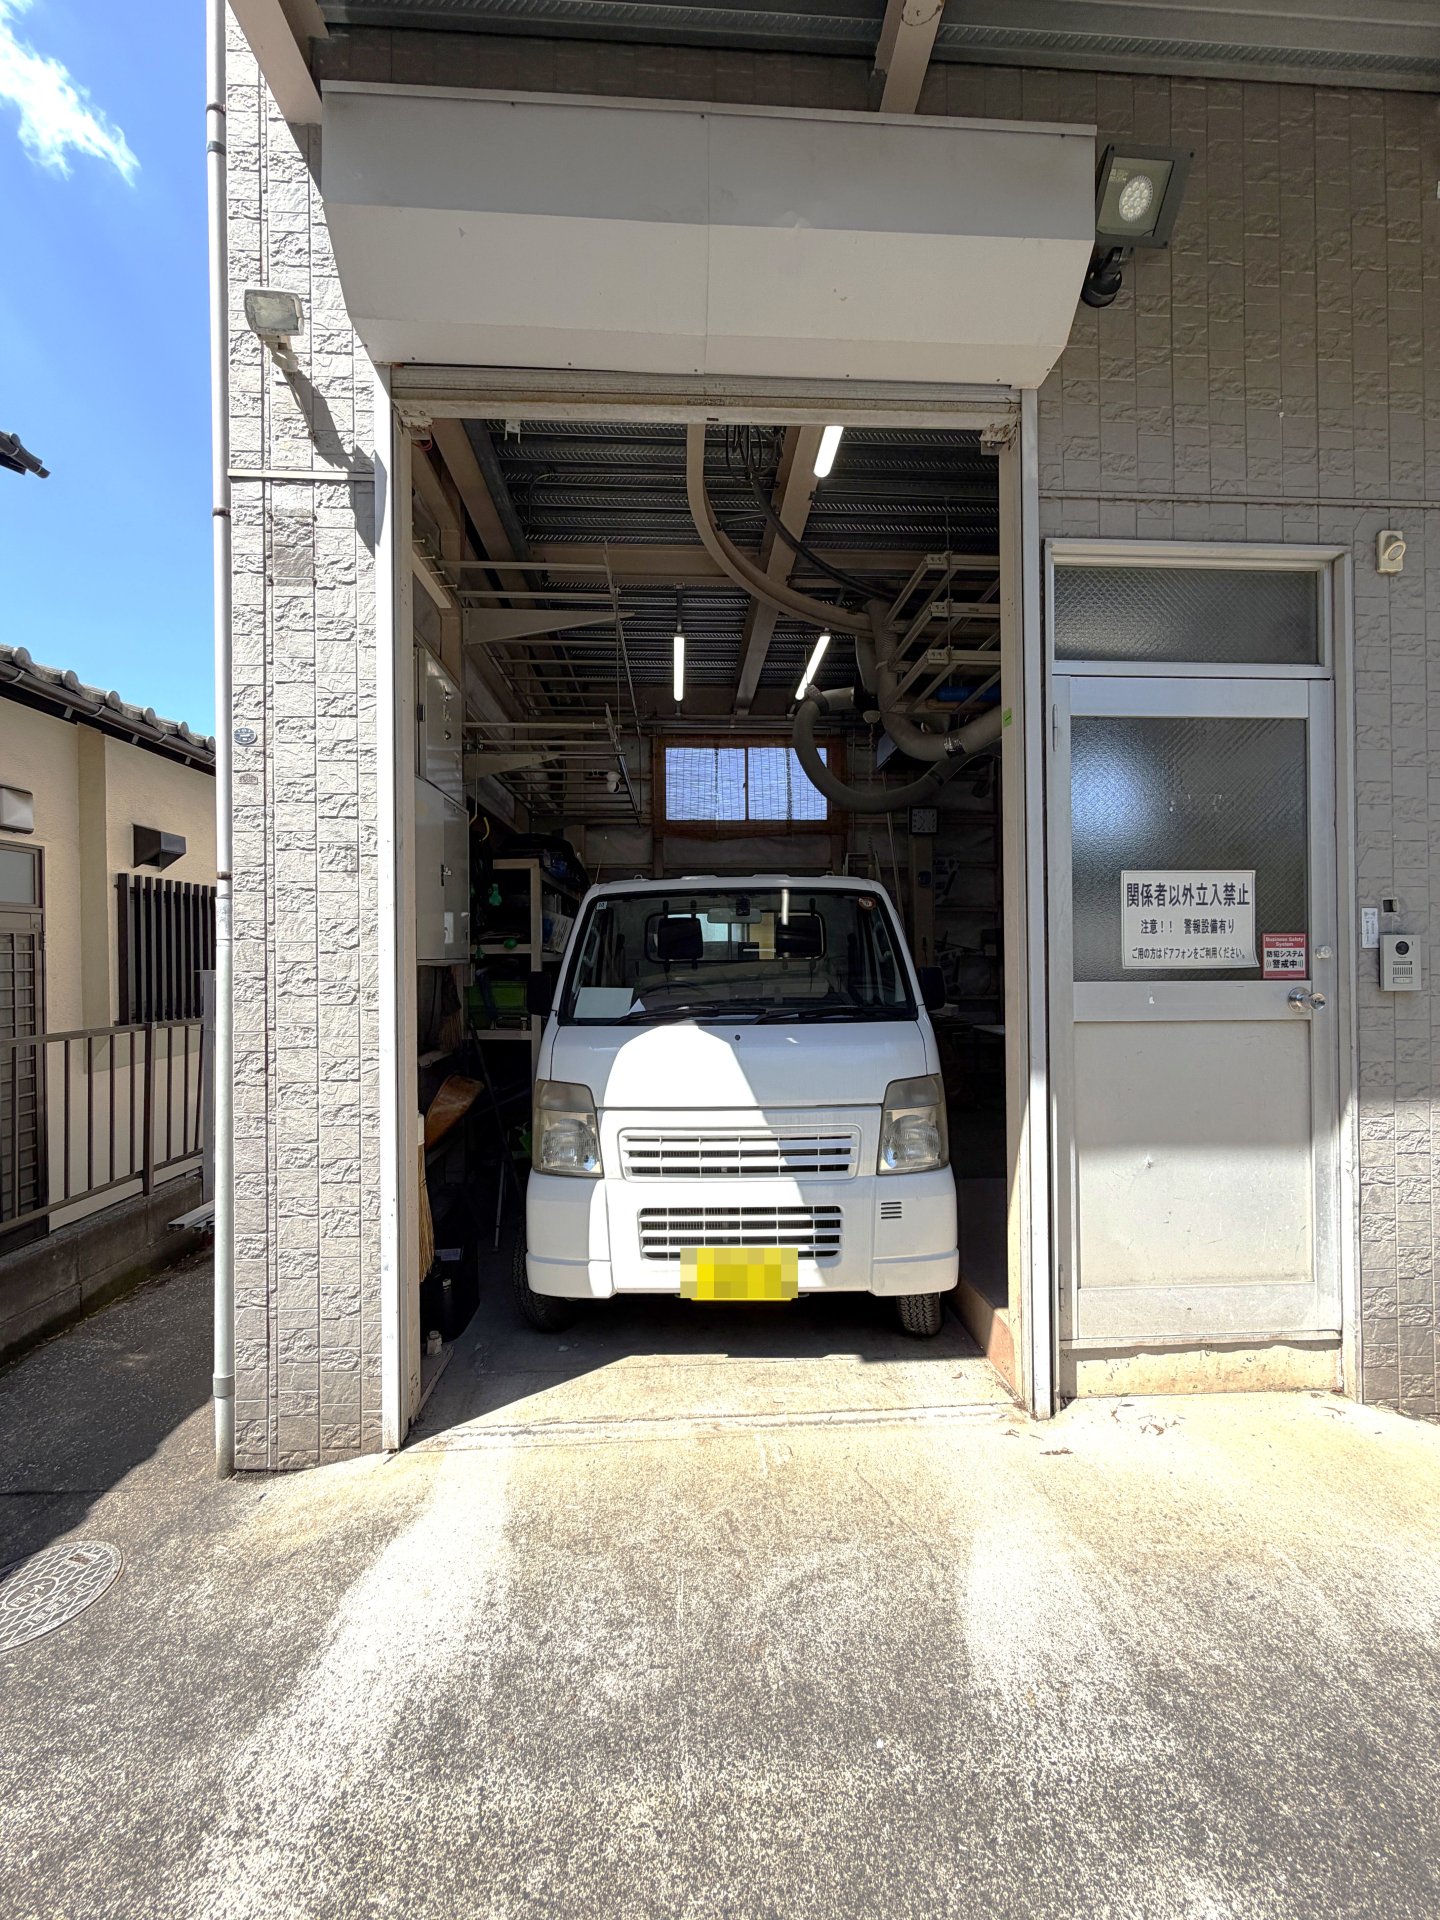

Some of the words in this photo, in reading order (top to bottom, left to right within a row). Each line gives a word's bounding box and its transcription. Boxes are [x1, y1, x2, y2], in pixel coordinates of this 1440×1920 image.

[1126, 882, 1250, 908] 関係者以外立入禁止
[1183, 918, 1235, 935] 警報設備有り
[1131, 947, 1246, 960] ご用の方はドアフォンをご利用ください。
[1266, 950, 1304, 958] 防犯システム
